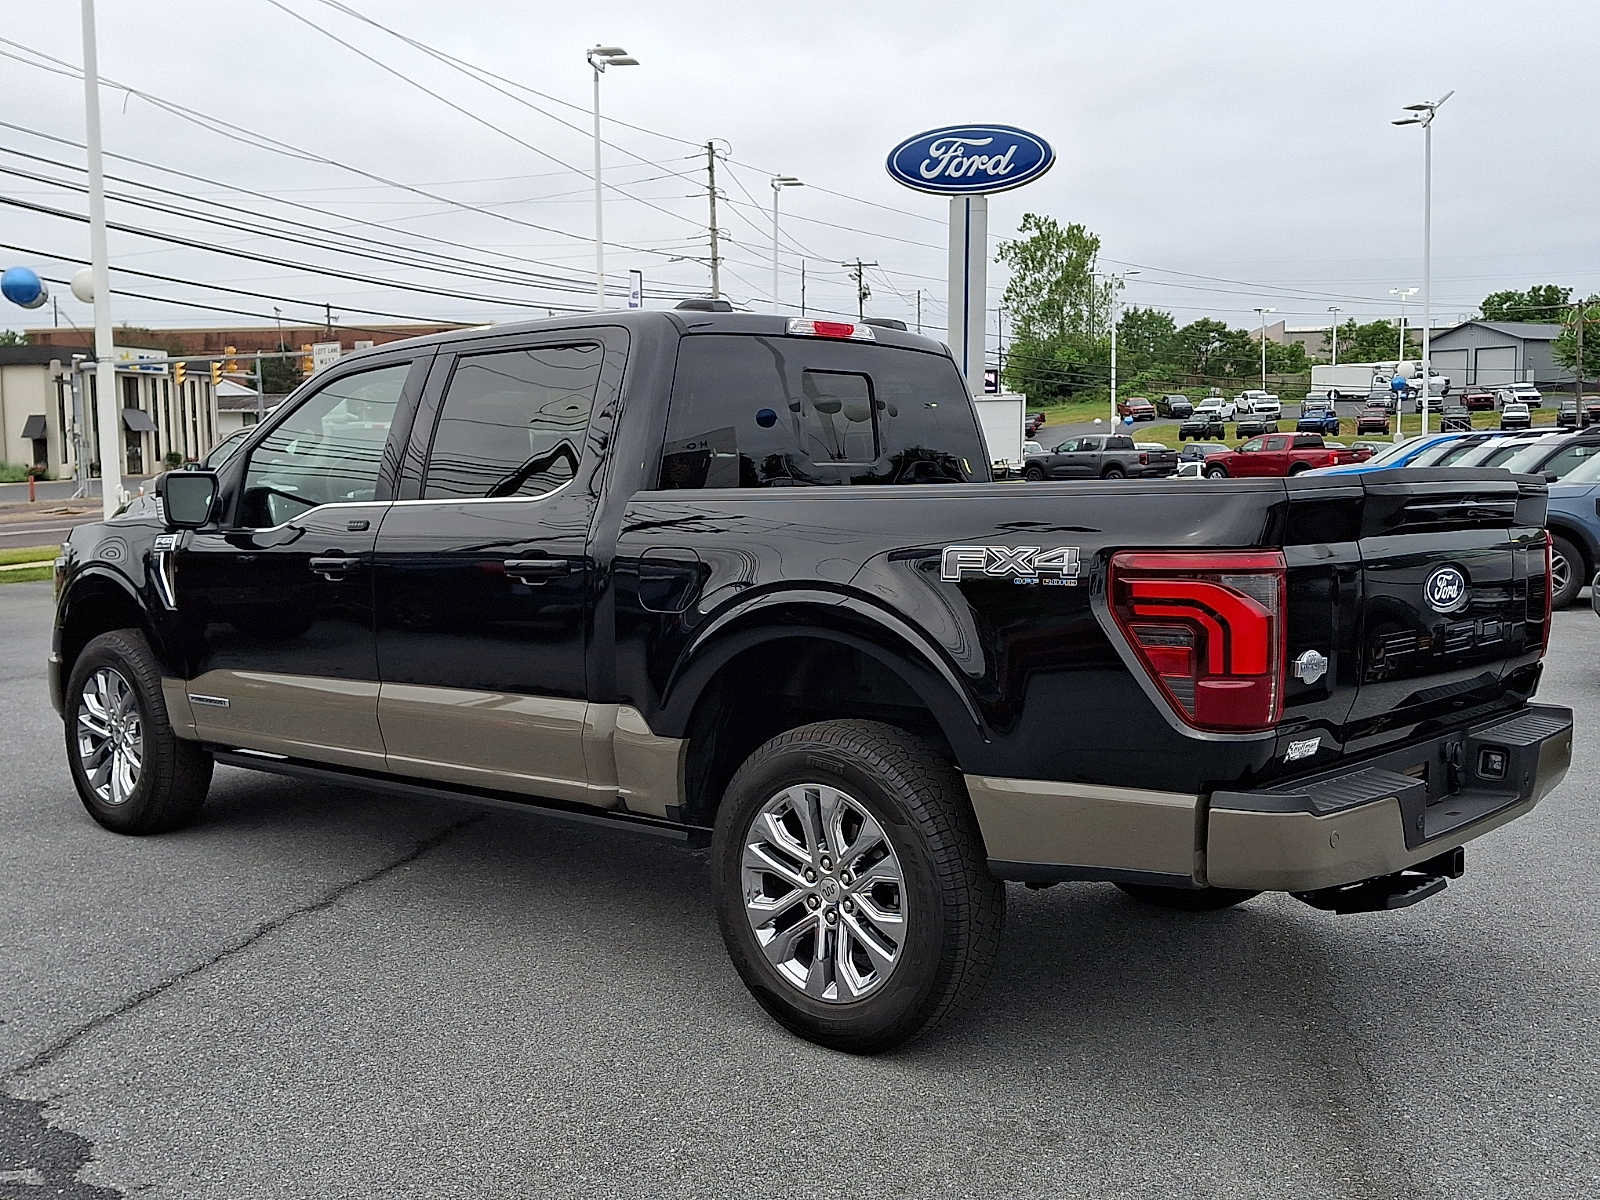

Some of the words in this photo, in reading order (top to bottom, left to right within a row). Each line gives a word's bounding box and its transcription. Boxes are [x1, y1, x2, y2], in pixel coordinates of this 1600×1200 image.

[919, 137, 1018, 180] Ford
[940, 546, 1081, 582] FX4
[1013, 577, 1040, 585] OFF
[1433, 573, 1460, 601] Ford
